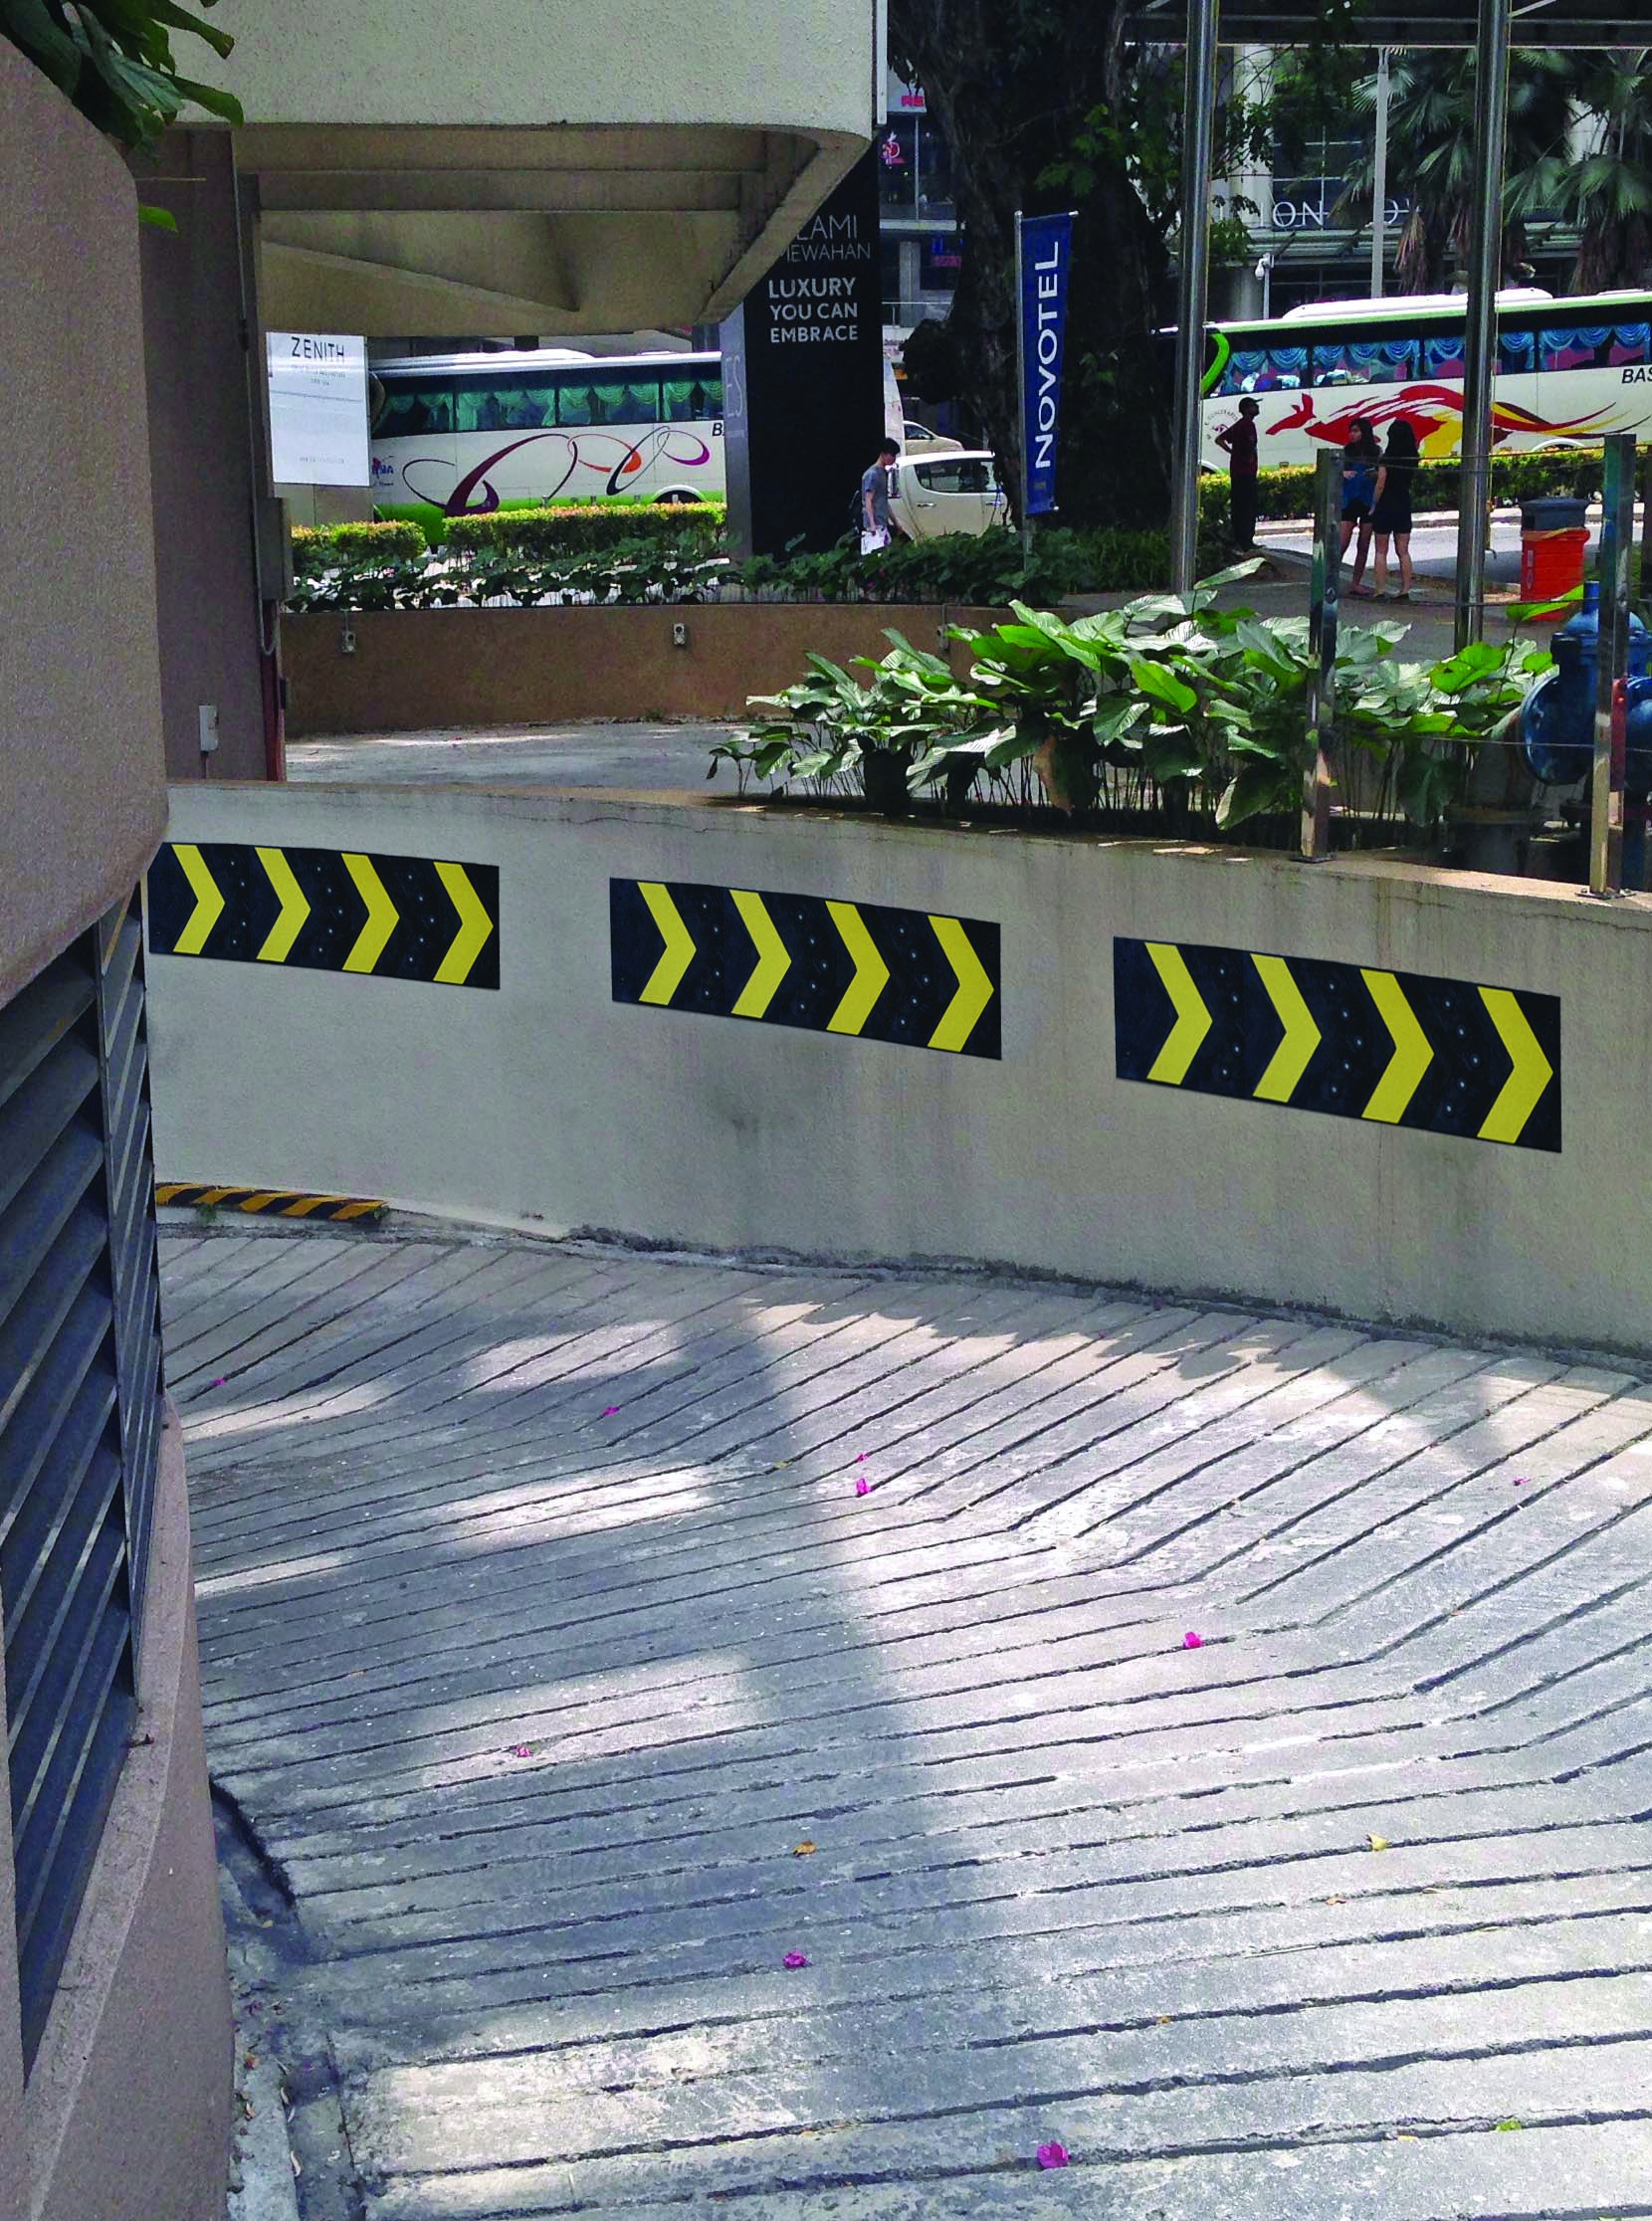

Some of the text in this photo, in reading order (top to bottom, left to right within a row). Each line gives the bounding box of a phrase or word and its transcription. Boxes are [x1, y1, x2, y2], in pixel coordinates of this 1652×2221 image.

[768, 277, 857, 299] LUXURY
[769, 302, 858, 321] YOU CAN
[770, 324, 859, 343] EMBRACE
[291, 336, 345, 362] ZENITH
[1034, 241, 1059, 469] NOVOTEL
[712, 422, 724, 437] B
